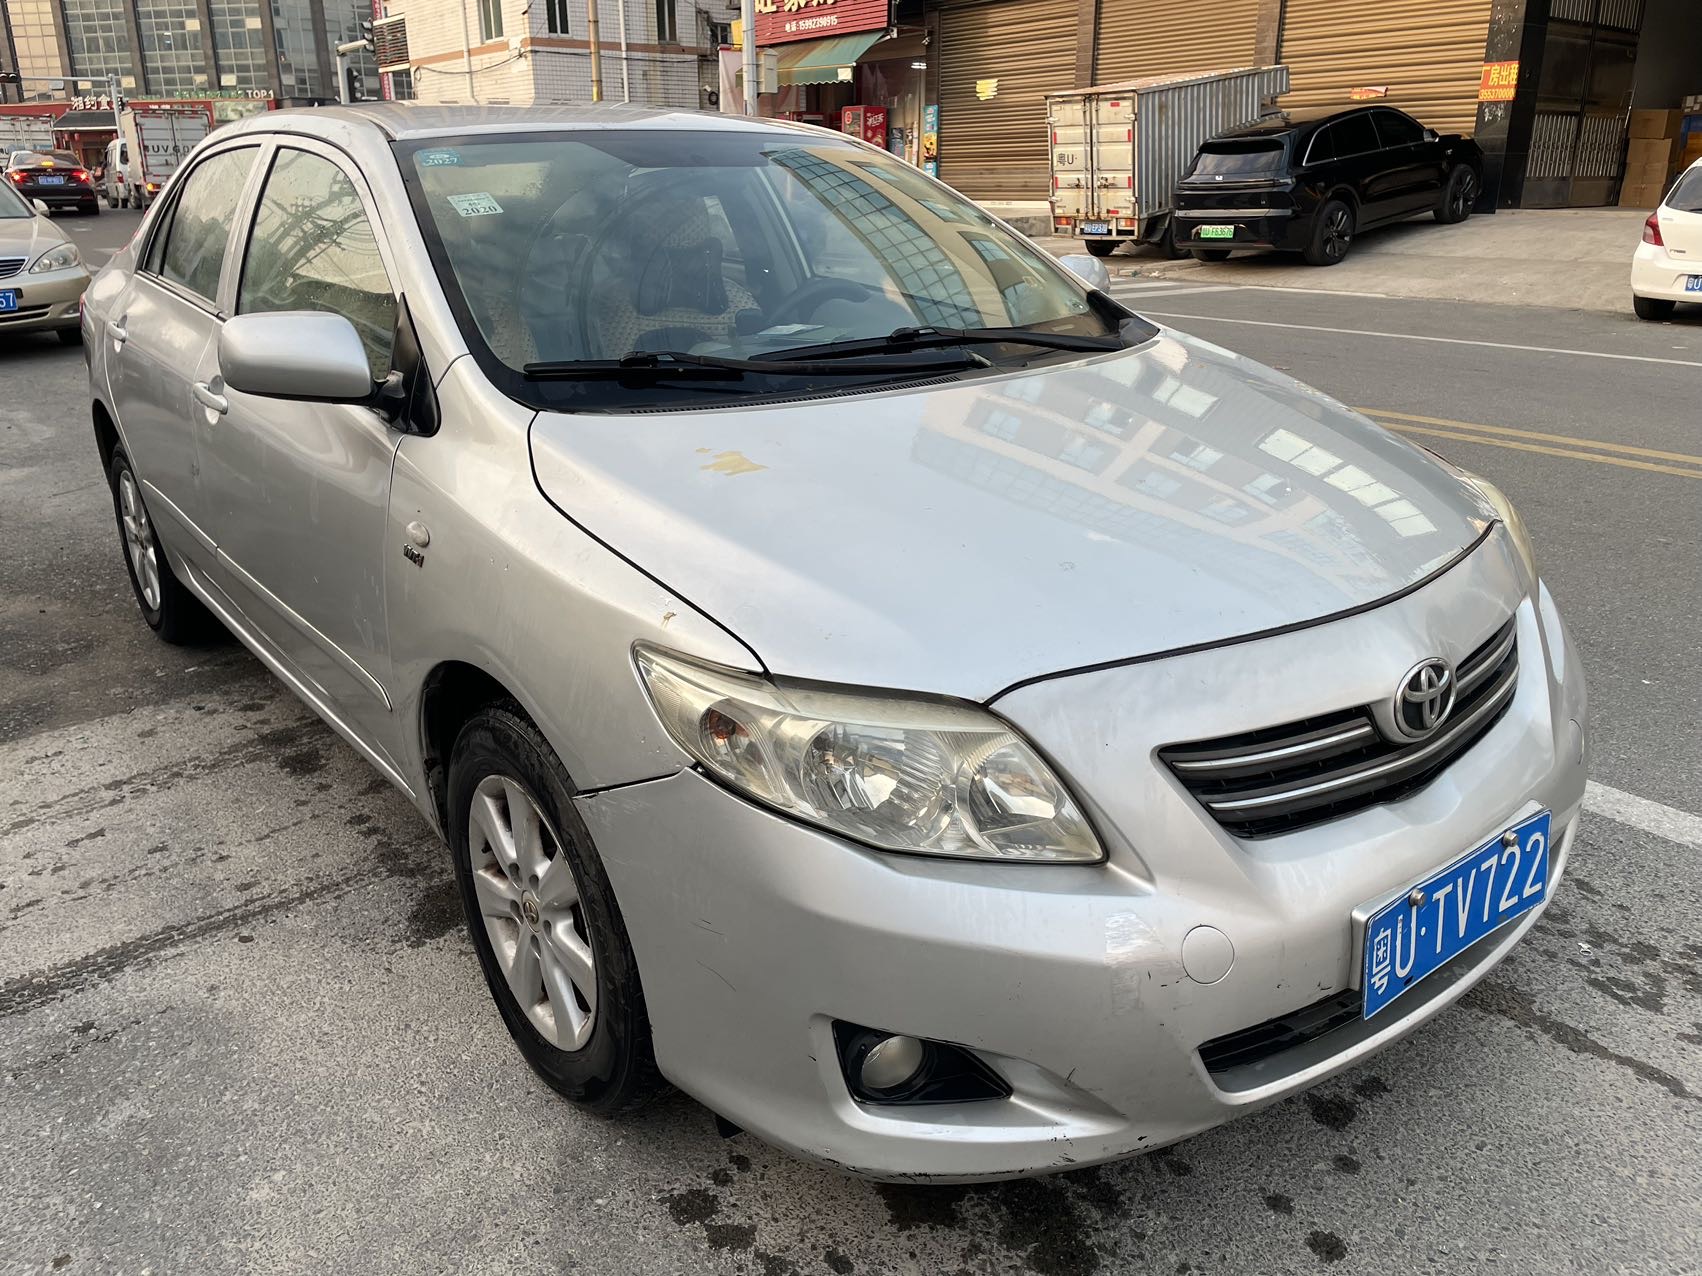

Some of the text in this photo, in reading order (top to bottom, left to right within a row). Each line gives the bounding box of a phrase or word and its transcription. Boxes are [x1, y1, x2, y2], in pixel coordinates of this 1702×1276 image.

[246, 90, 274, 99] TOP1
[423, 157, 457, 166] 2027
[462, 205, 497, 215] 2020
